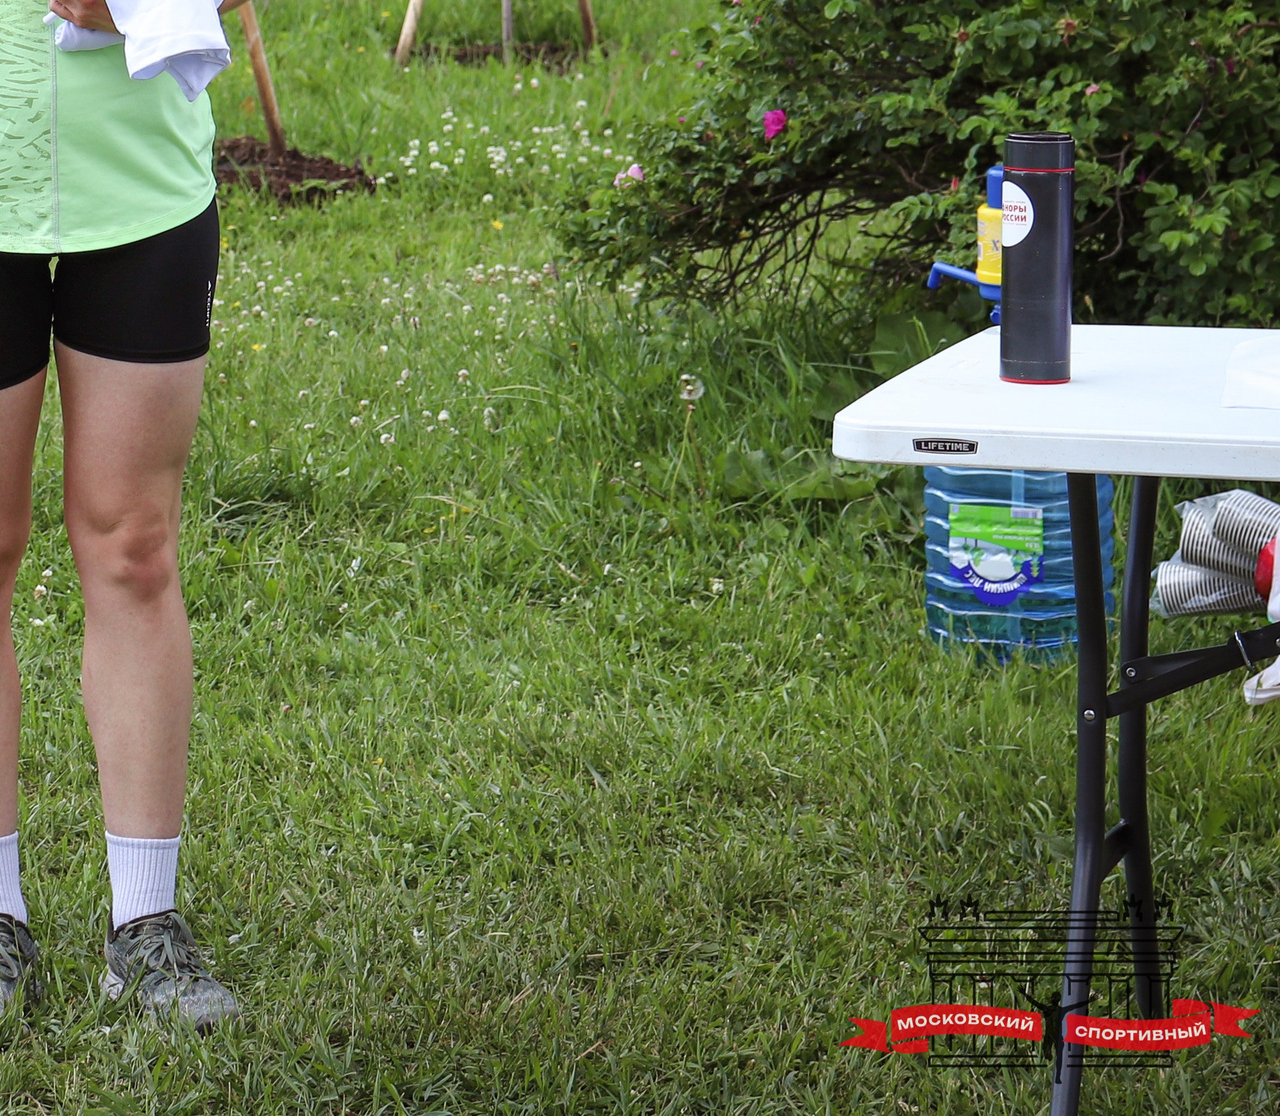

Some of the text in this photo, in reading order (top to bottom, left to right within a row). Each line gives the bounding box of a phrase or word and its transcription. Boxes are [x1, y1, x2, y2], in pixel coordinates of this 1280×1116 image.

[921, 441, 970, 451] LIFETIME
[963, 569, 1028, 594] ШИШКИН ЛЕС
